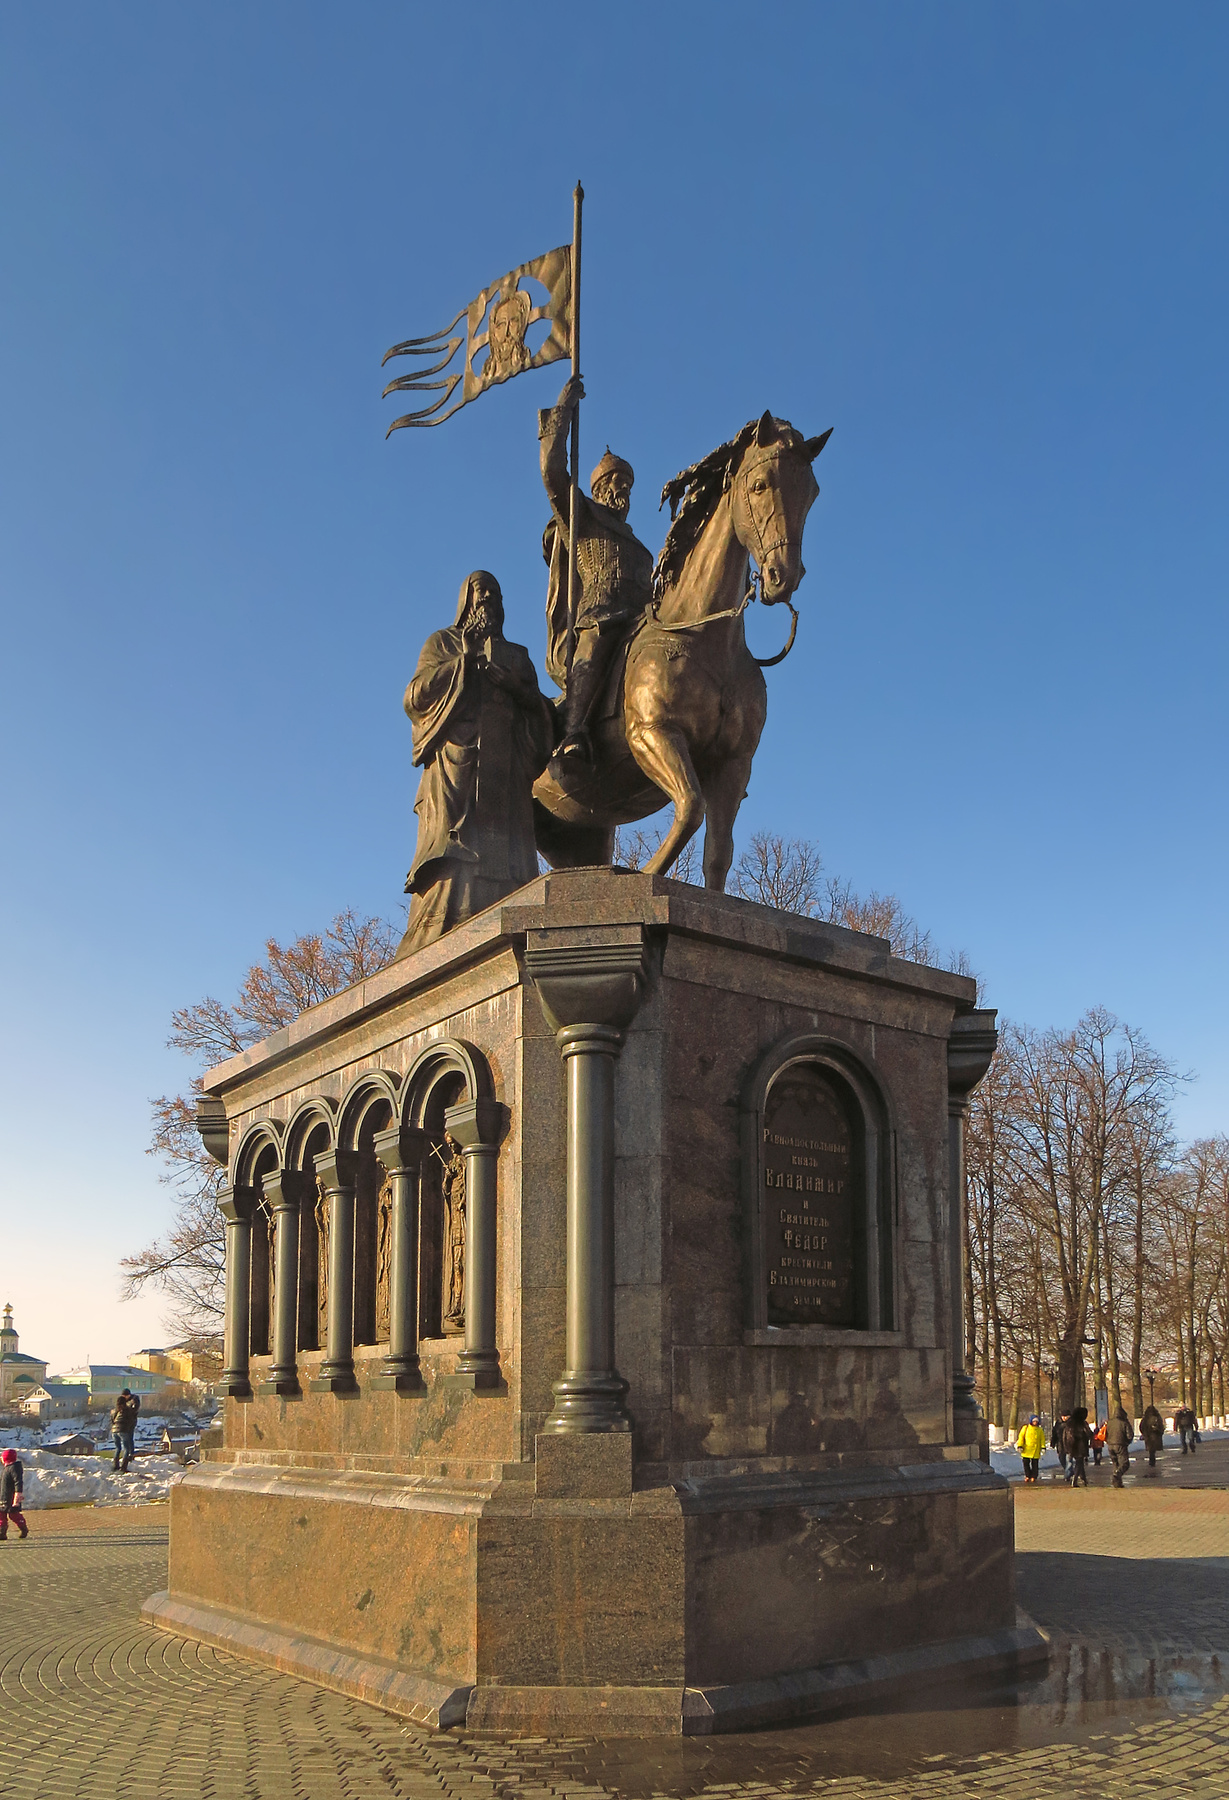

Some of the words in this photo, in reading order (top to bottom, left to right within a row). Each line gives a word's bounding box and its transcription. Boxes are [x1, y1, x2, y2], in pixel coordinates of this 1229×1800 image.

[765, 1168, 844, 1194] Владимир
[803, 1200, 809, 1209] и
[779, 1208, 830, 1228] Святитель
